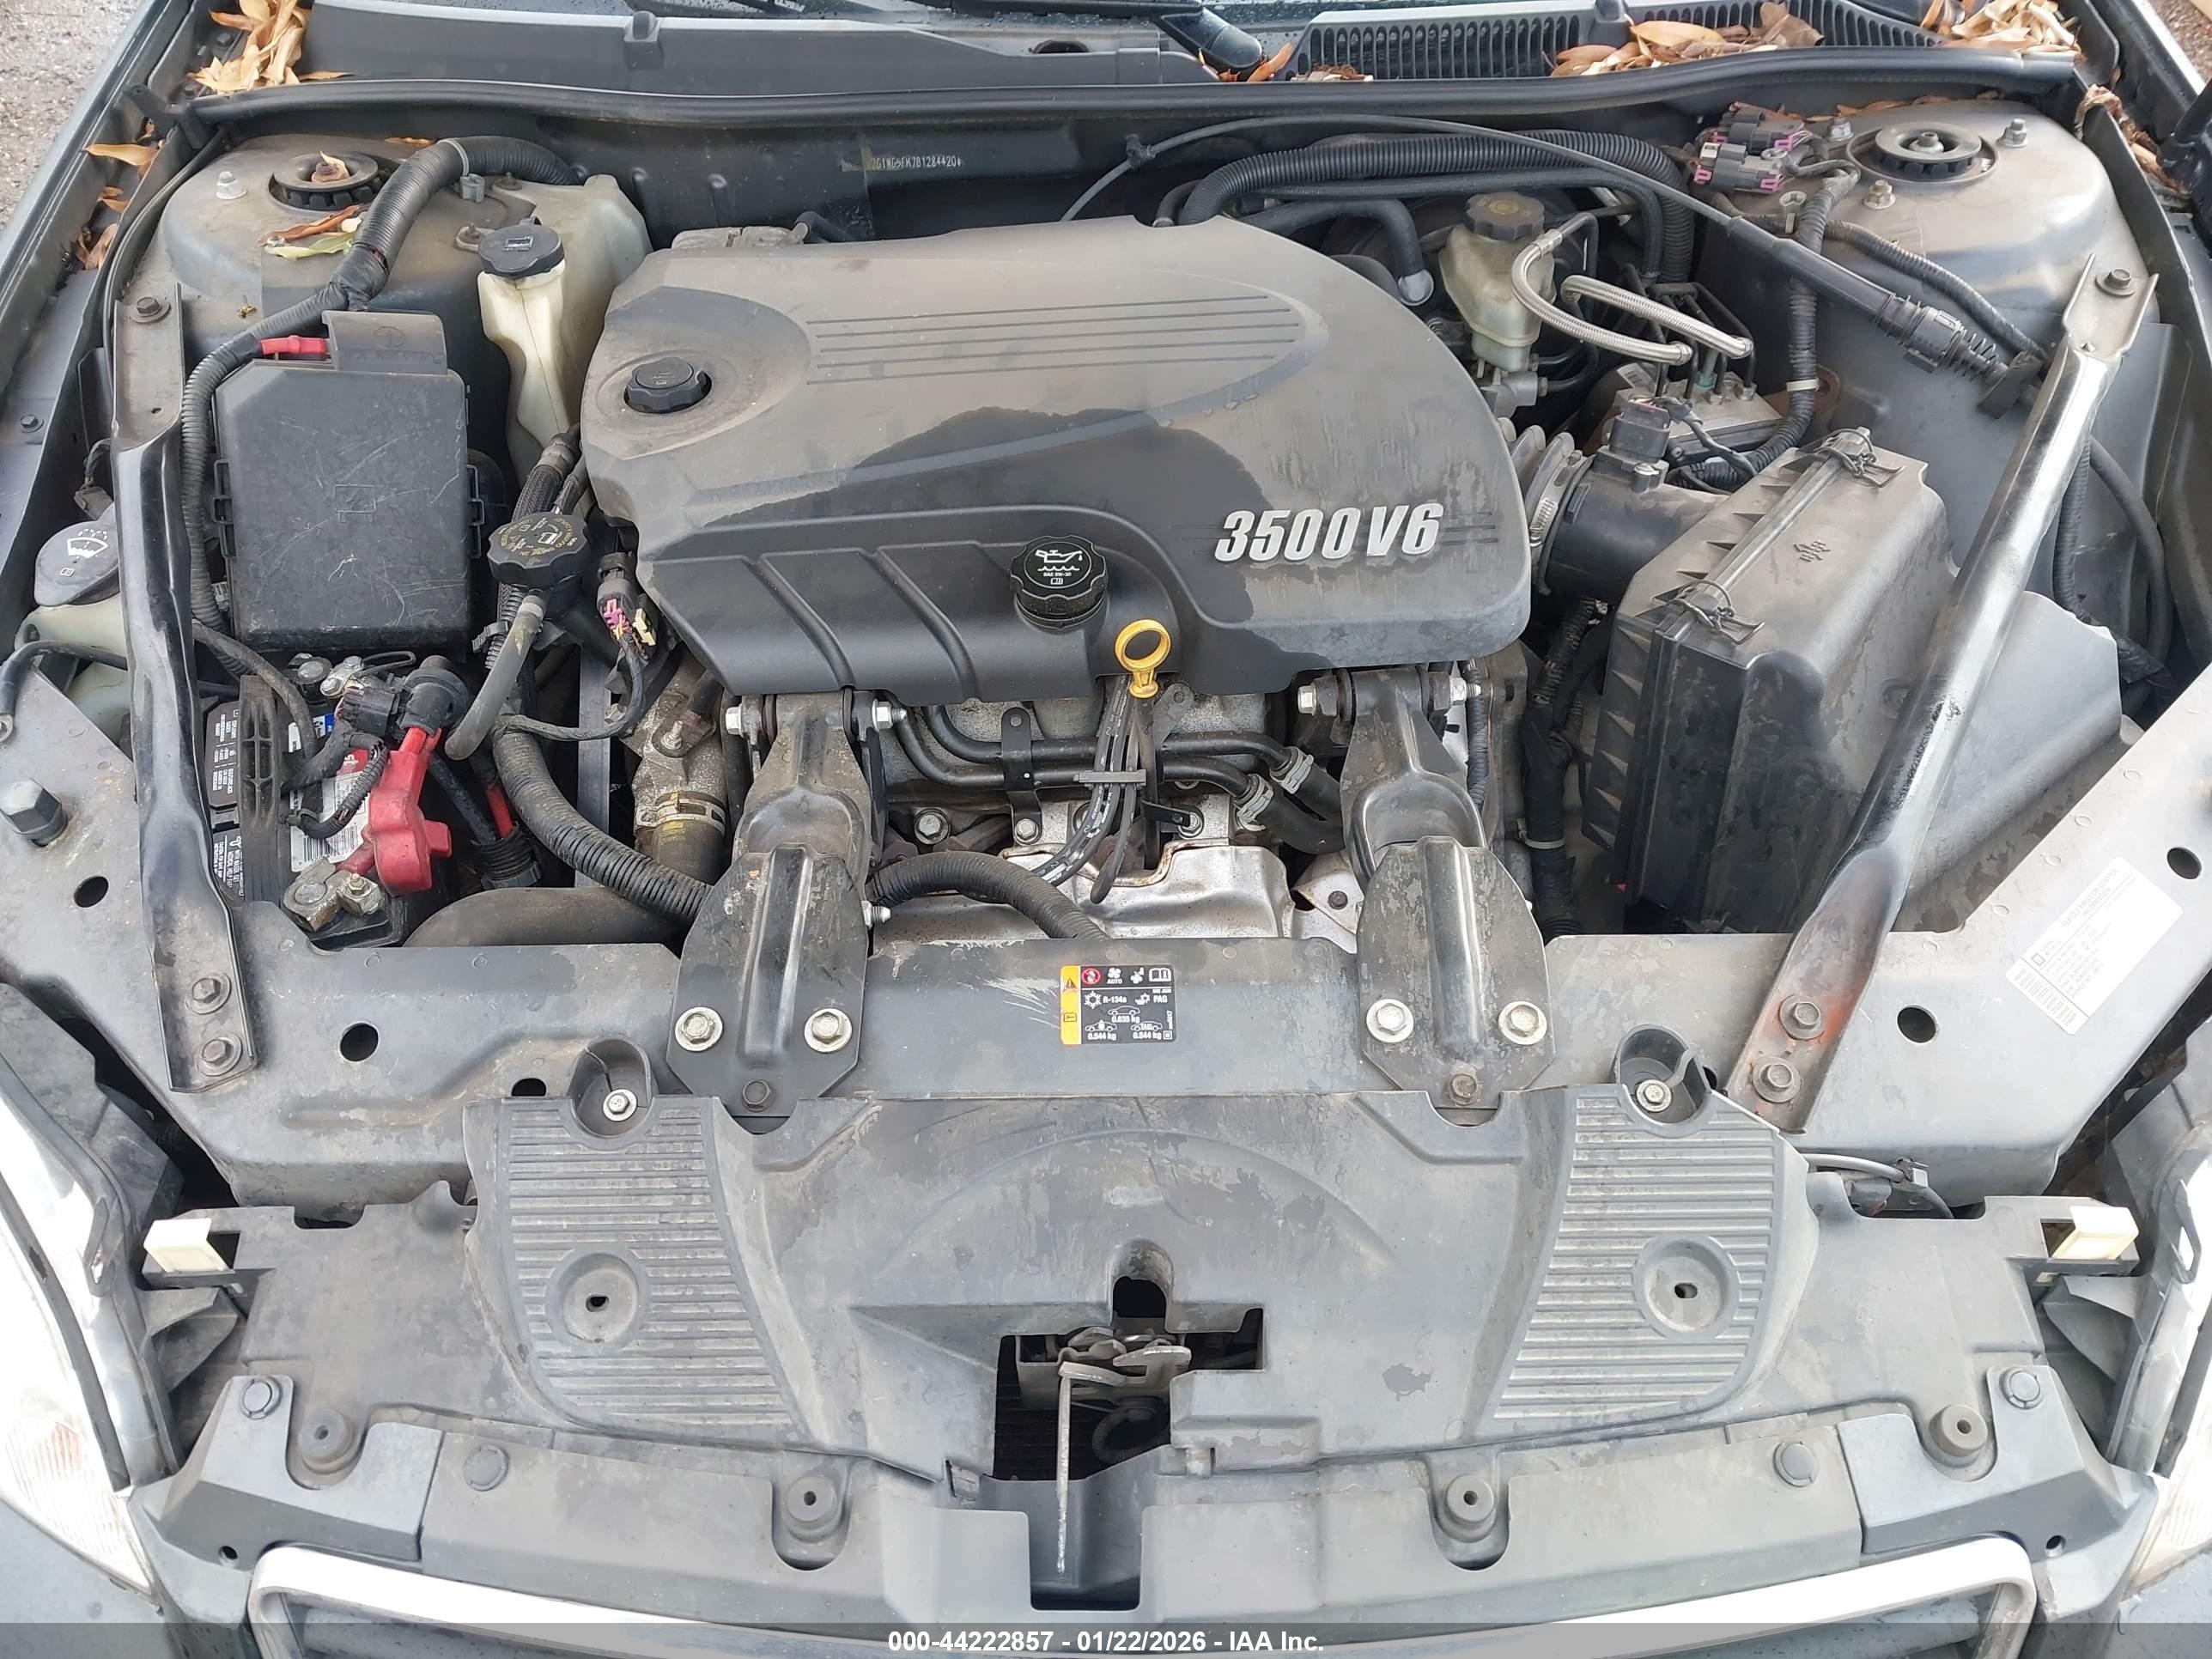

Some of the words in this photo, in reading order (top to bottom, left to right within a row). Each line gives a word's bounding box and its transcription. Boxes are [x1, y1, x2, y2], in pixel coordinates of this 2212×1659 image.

[1214, 507, 1362, 562] 3500
[1366, 503, 1443, 556] V6
[1131, 1015, 1140, 1024] kg
[1087, 1032, 1107, 1041] 0.544
[1107, 1031, 1117, 1041] kg
[1152, 1031, 1162, 1040] kg
